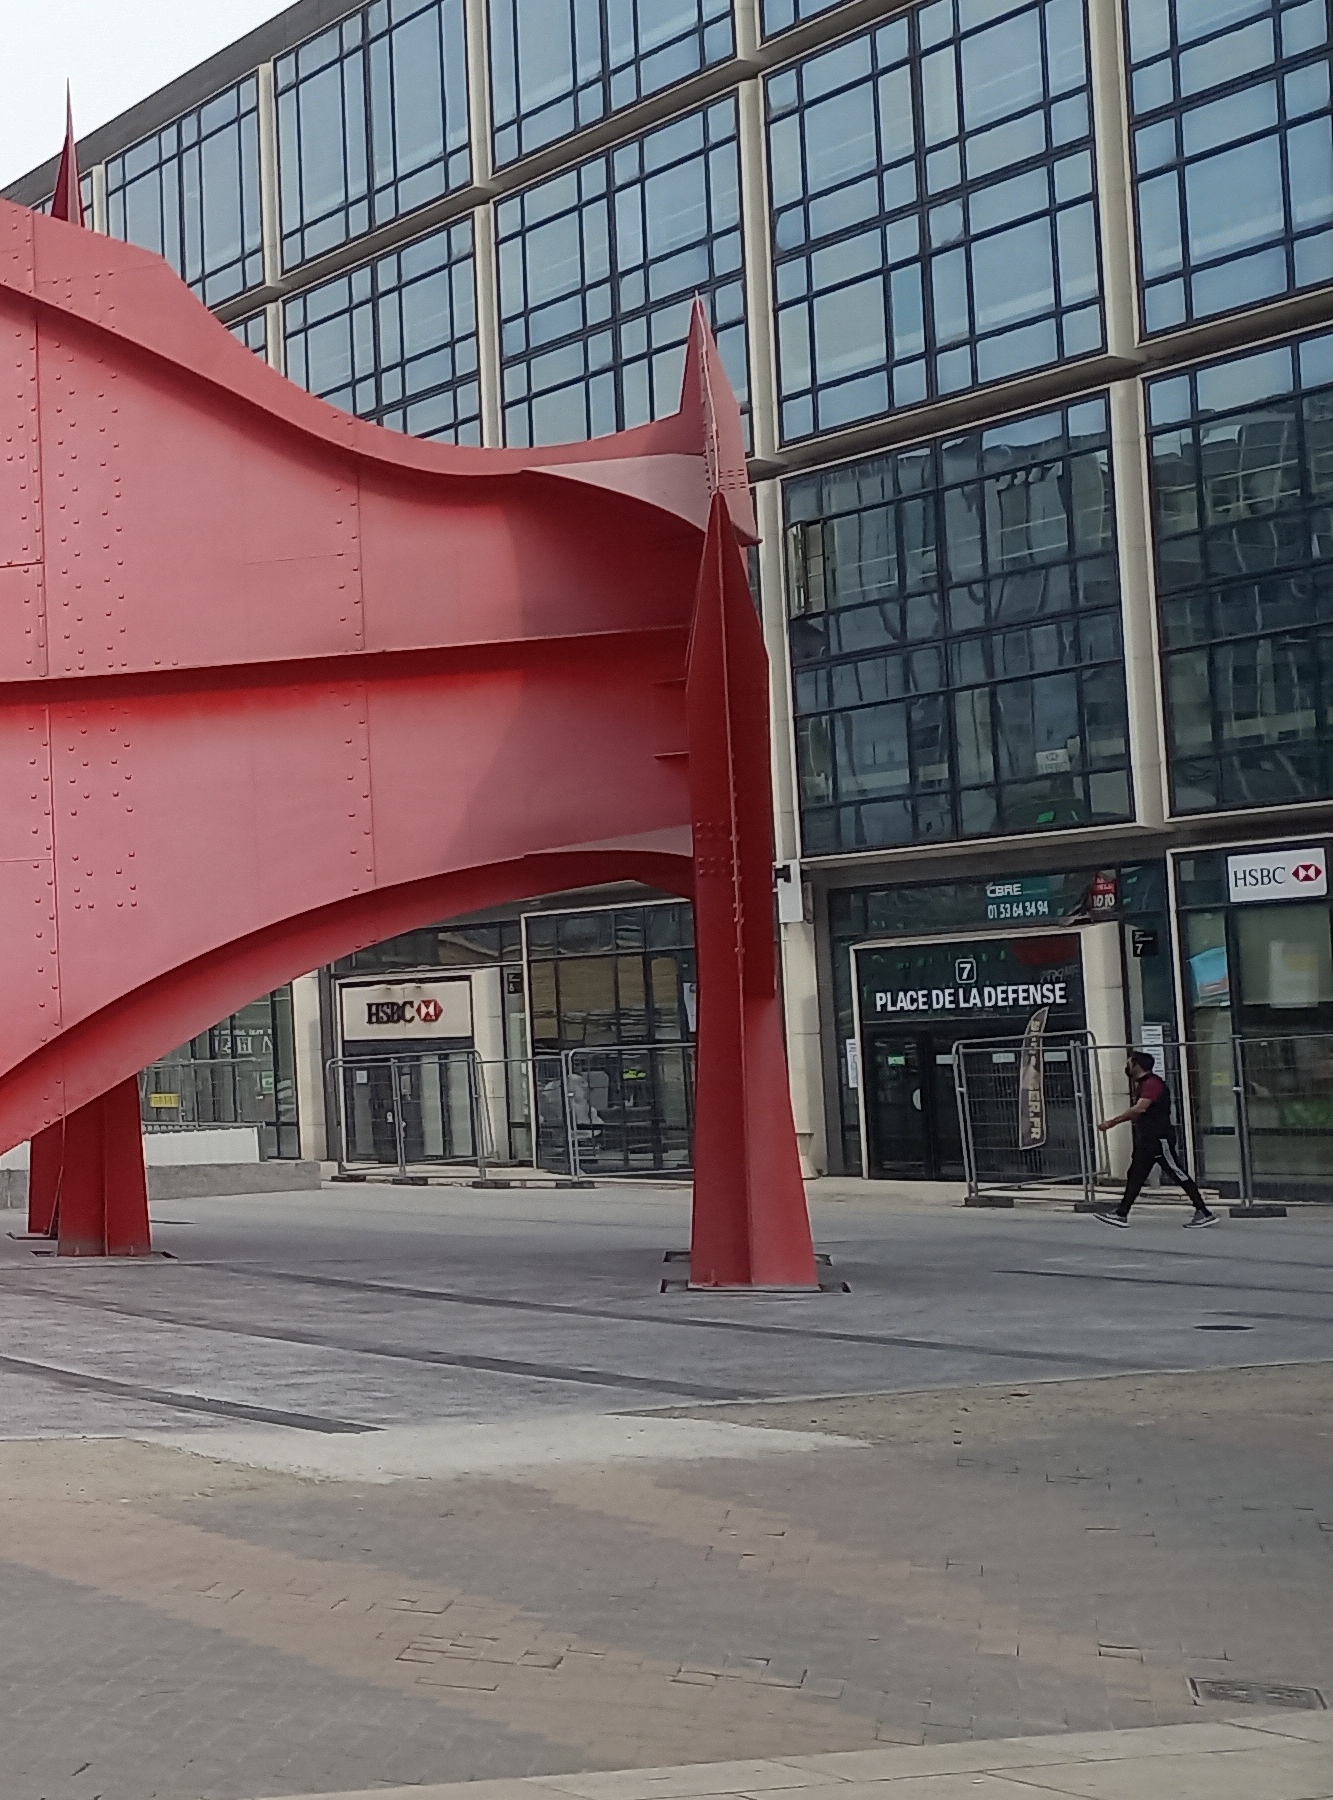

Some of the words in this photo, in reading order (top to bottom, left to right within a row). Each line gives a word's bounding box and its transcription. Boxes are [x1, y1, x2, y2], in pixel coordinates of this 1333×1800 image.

[1233, 866, 1287, 888] HSBC
[986, 883, 1023, 898] CBRE
[987, 904, 998, 919] 01
[1000, 903, 1011, 919] 53
[1012, 901, 1024, 918] 64
[1024, 900, 1037, 917] 34
[1037, 900, 1049, 916] 94
[959, 963, 972, 980] 7
[876, 989, 929, 1012] PLACE
[933, 988, 956, 1010] DE
[959, 986, 983, 1008] LA
[984, 983, 1067, 1007] DEFENSE
[366, 1000, 416, 1025] HSBC
